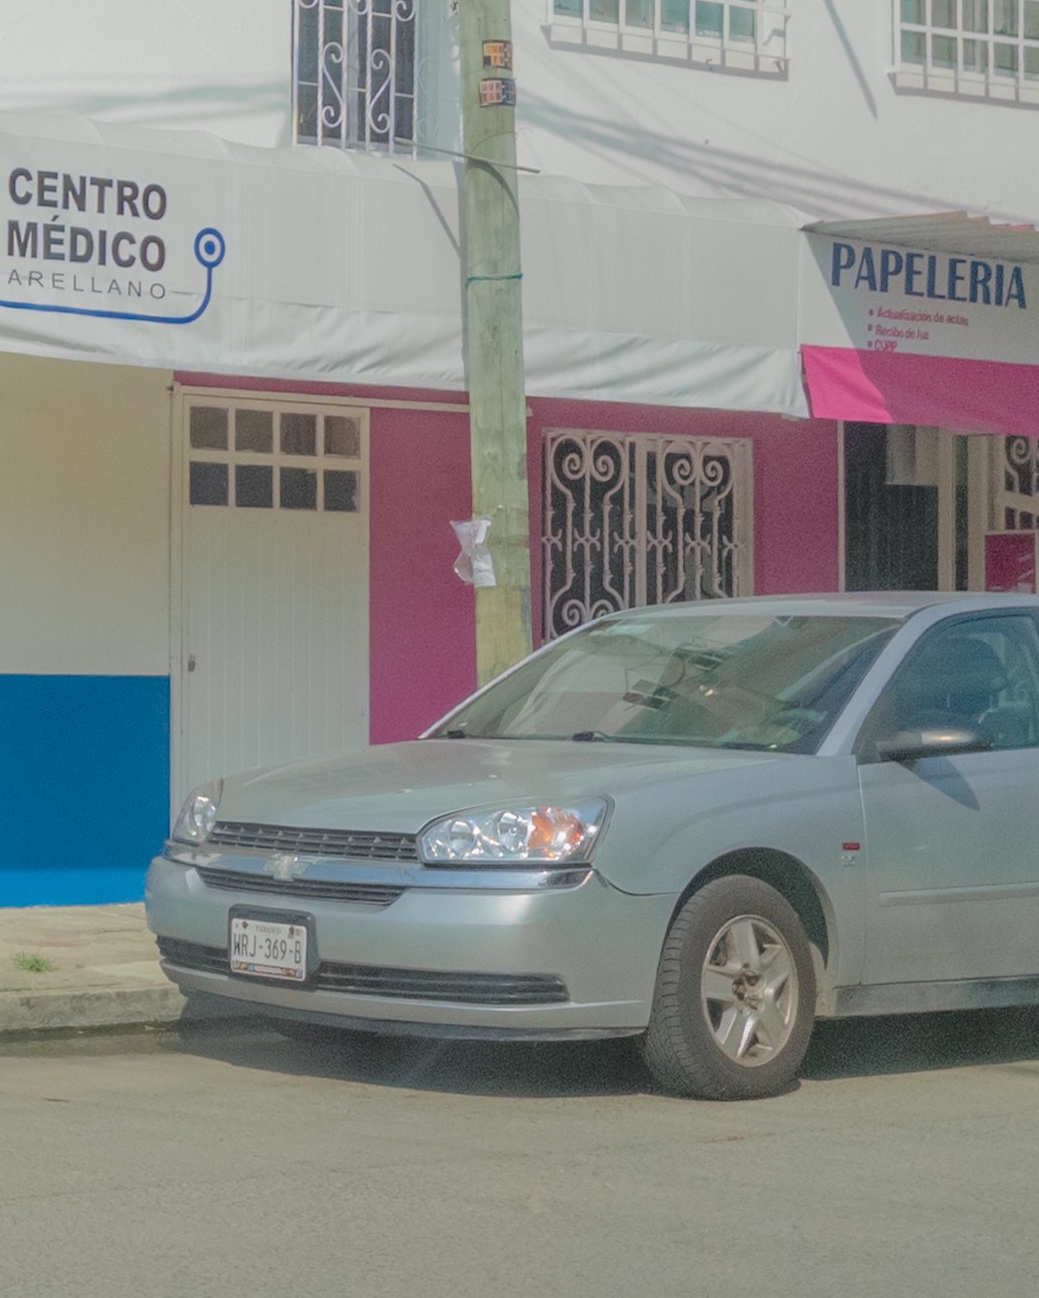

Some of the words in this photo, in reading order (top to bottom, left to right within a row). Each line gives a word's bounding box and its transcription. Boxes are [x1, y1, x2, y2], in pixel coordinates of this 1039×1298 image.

[8, 167, 167, 221] CENTRO
[7, 215, 166, 272] MÉDICO
[7, 269, 166, 300] ARELLANO
[831, 242, 1027, 309] PAPELERIA
[933, 311, 945, 323] de
[233, 933, 302, 964] WRJ-369-B
